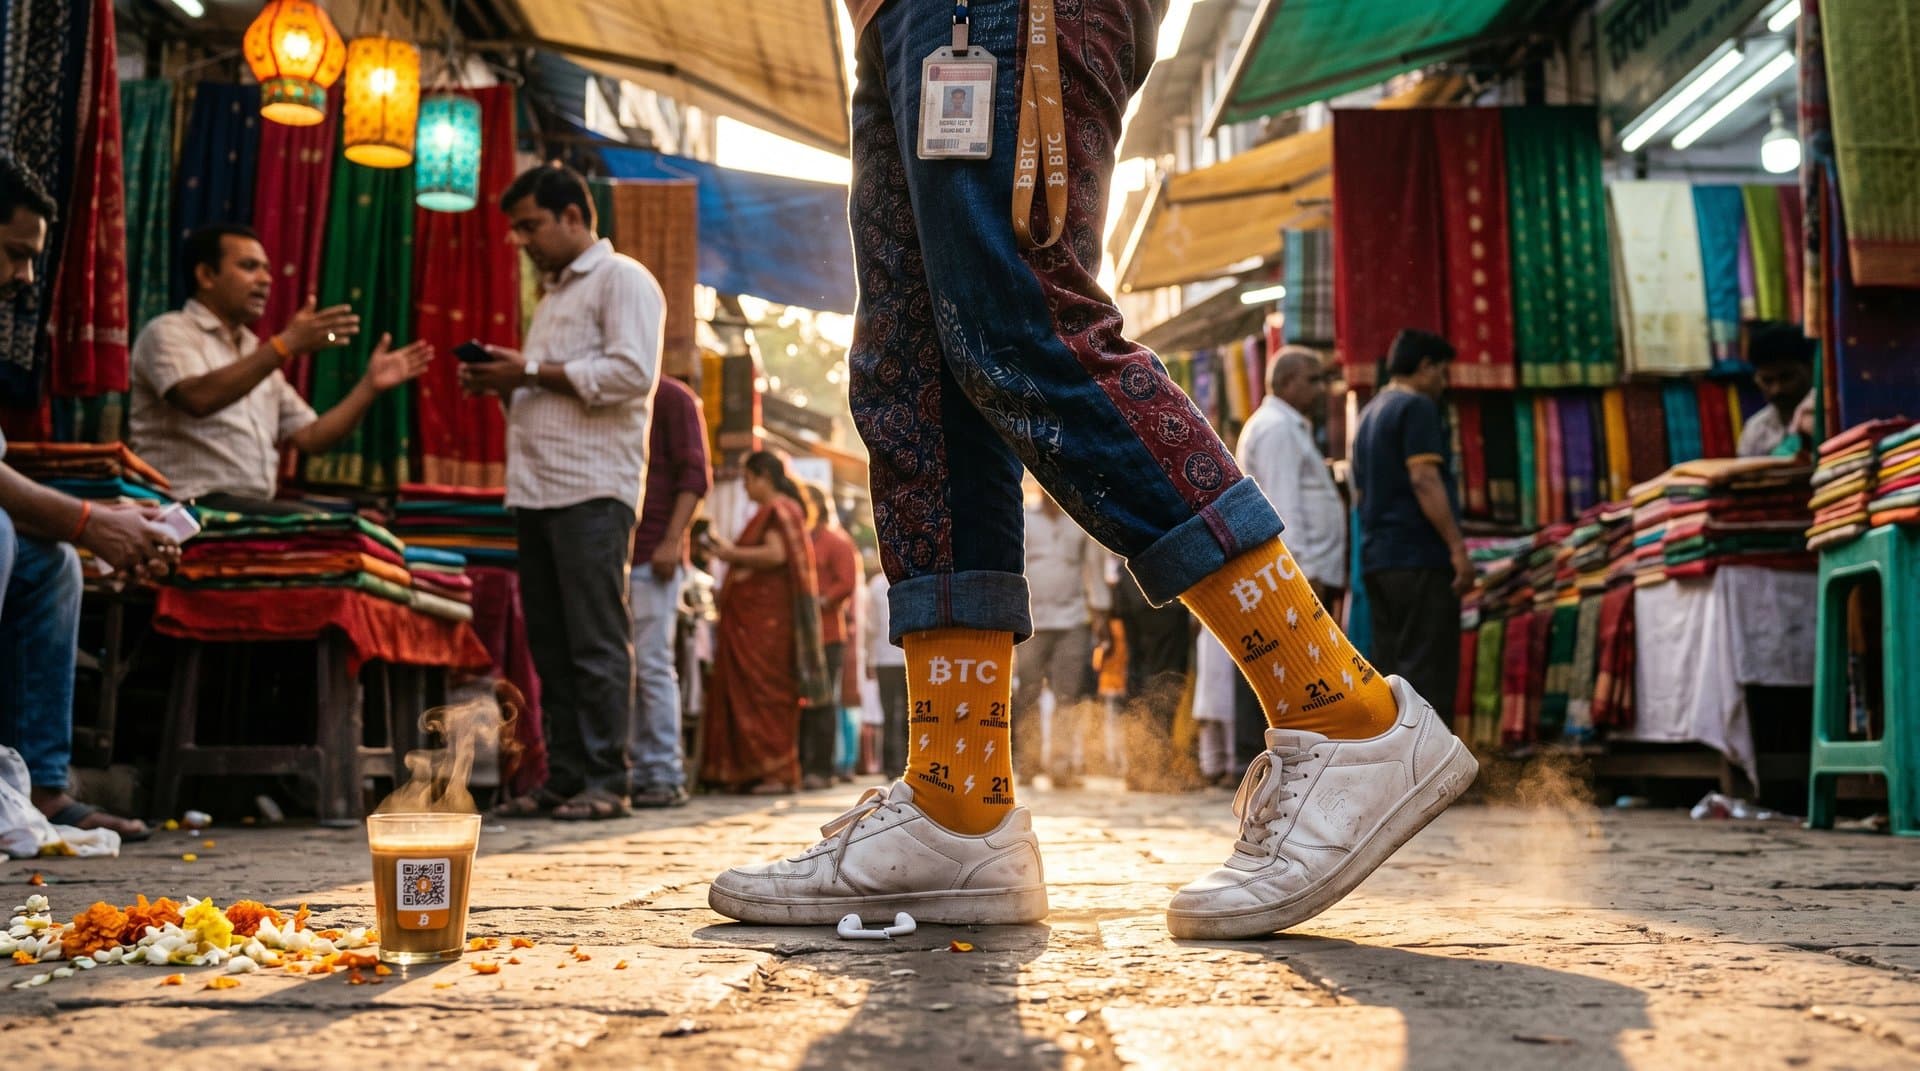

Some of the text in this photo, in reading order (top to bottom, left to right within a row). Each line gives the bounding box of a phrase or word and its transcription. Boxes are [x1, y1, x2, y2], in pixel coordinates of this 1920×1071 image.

[1031, 12, 1047, 44] BTC
[1020, 137, 1036, 170] BTC
[1048, 132, 1064, 165] BTC
[1241, 628, 1265, 650] 21
[1243, 638, 1280, 663] million
[1305, 678, 1330, 698] 21
[915, 700, 931, 714] 21
[990, 702, 1005, 717] 21
[1302, 690, 1345, 712] million
[929, 762, 949, 779] 21
[918, 772, 955, 793] million
[992, 777, 1009, 792] 21
